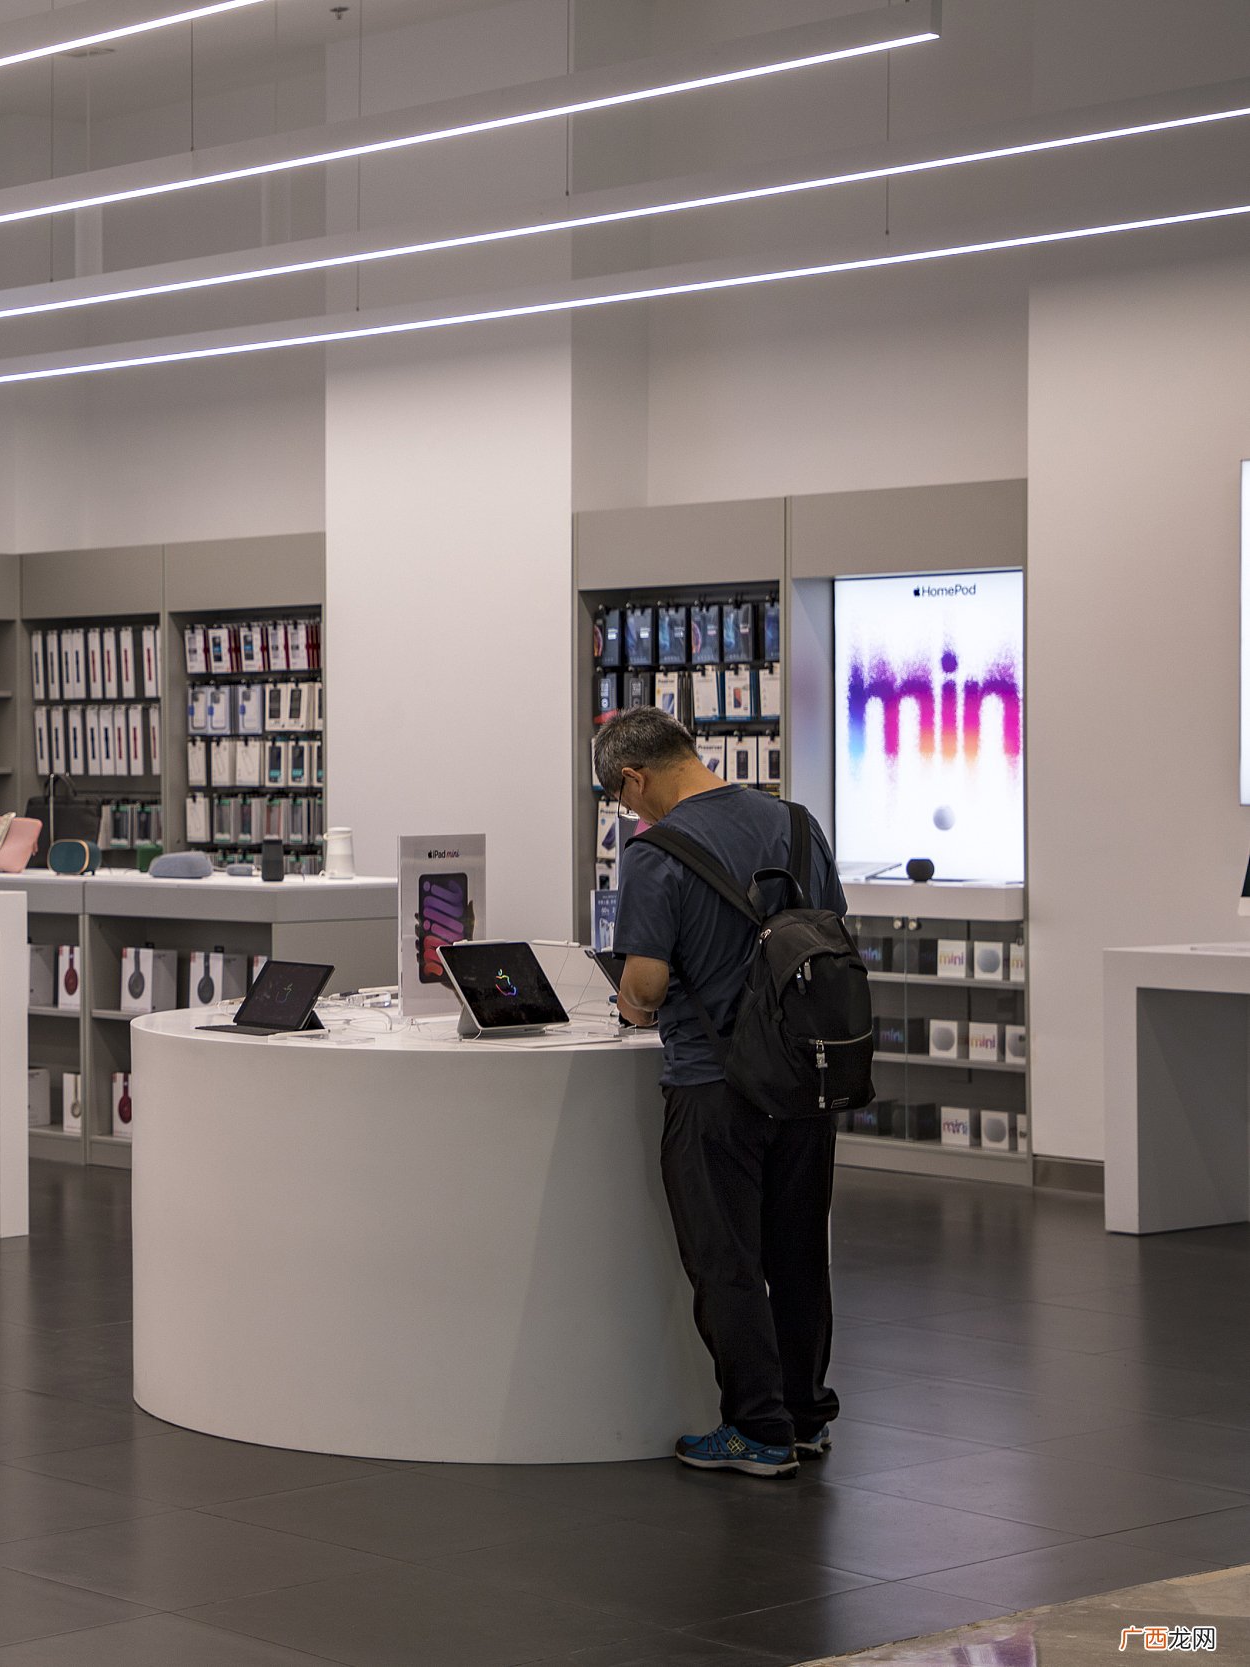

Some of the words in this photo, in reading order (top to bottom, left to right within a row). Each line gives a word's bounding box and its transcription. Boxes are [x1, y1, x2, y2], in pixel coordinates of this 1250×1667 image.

[921, 584, 977, 598] HomePod
[432, 849, 446, 859] iPad
[447, 849, 460, 858] mini
[938, 950, 964, 967] mini
[970, 1033, 996, 1050] mini
[942, 1117, 969, 1136] mini
